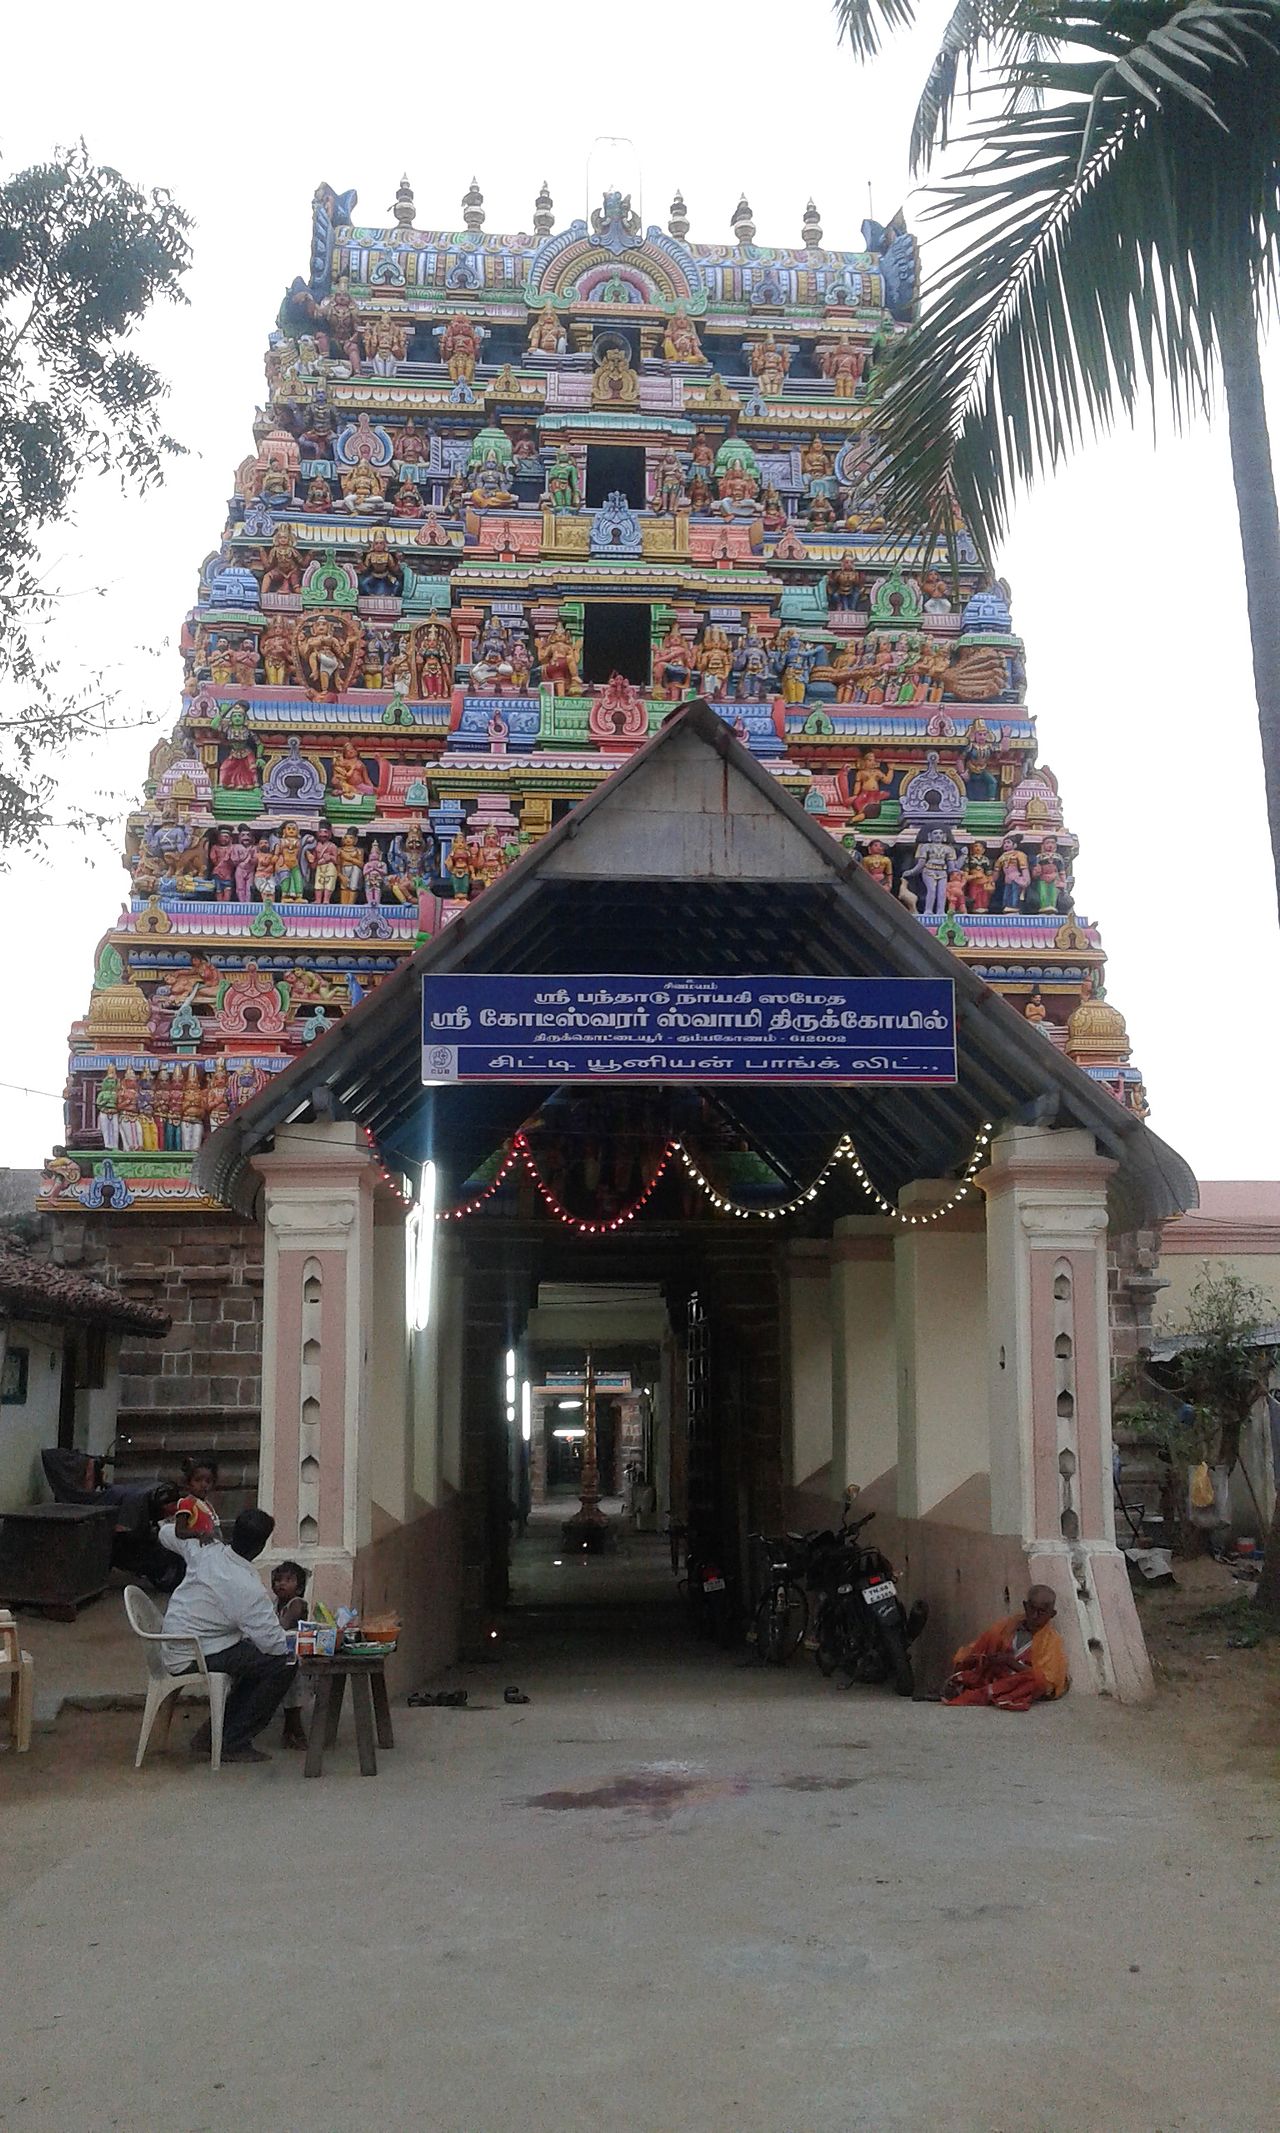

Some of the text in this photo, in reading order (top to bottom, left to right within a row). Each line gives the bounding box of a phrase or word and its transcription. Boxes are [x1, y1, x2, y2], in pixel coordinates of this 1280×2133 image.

[578, 989, 670, 1005] பந்தாடு
[676, 990, 752, 1006] நாயகி
[759, 991, 847, 1006] ஸமேத
[480, 1006, 651, 1029] கோடீஸ்வரர்
[657, 1006, 762, 1030] ஸ்வாமி
[768, 1006, 949, 1032] திருக்கோயில்
[677, 1033, 777, 1043] கும்பகோணம்
[789, 1034, 847, 1043] 612002
[488, 1055, 576, 1072] சிட்டி
[588, 1054, 734, 1073] யூனியன்
[746, 1056, 841, 1069] பாங்க்
